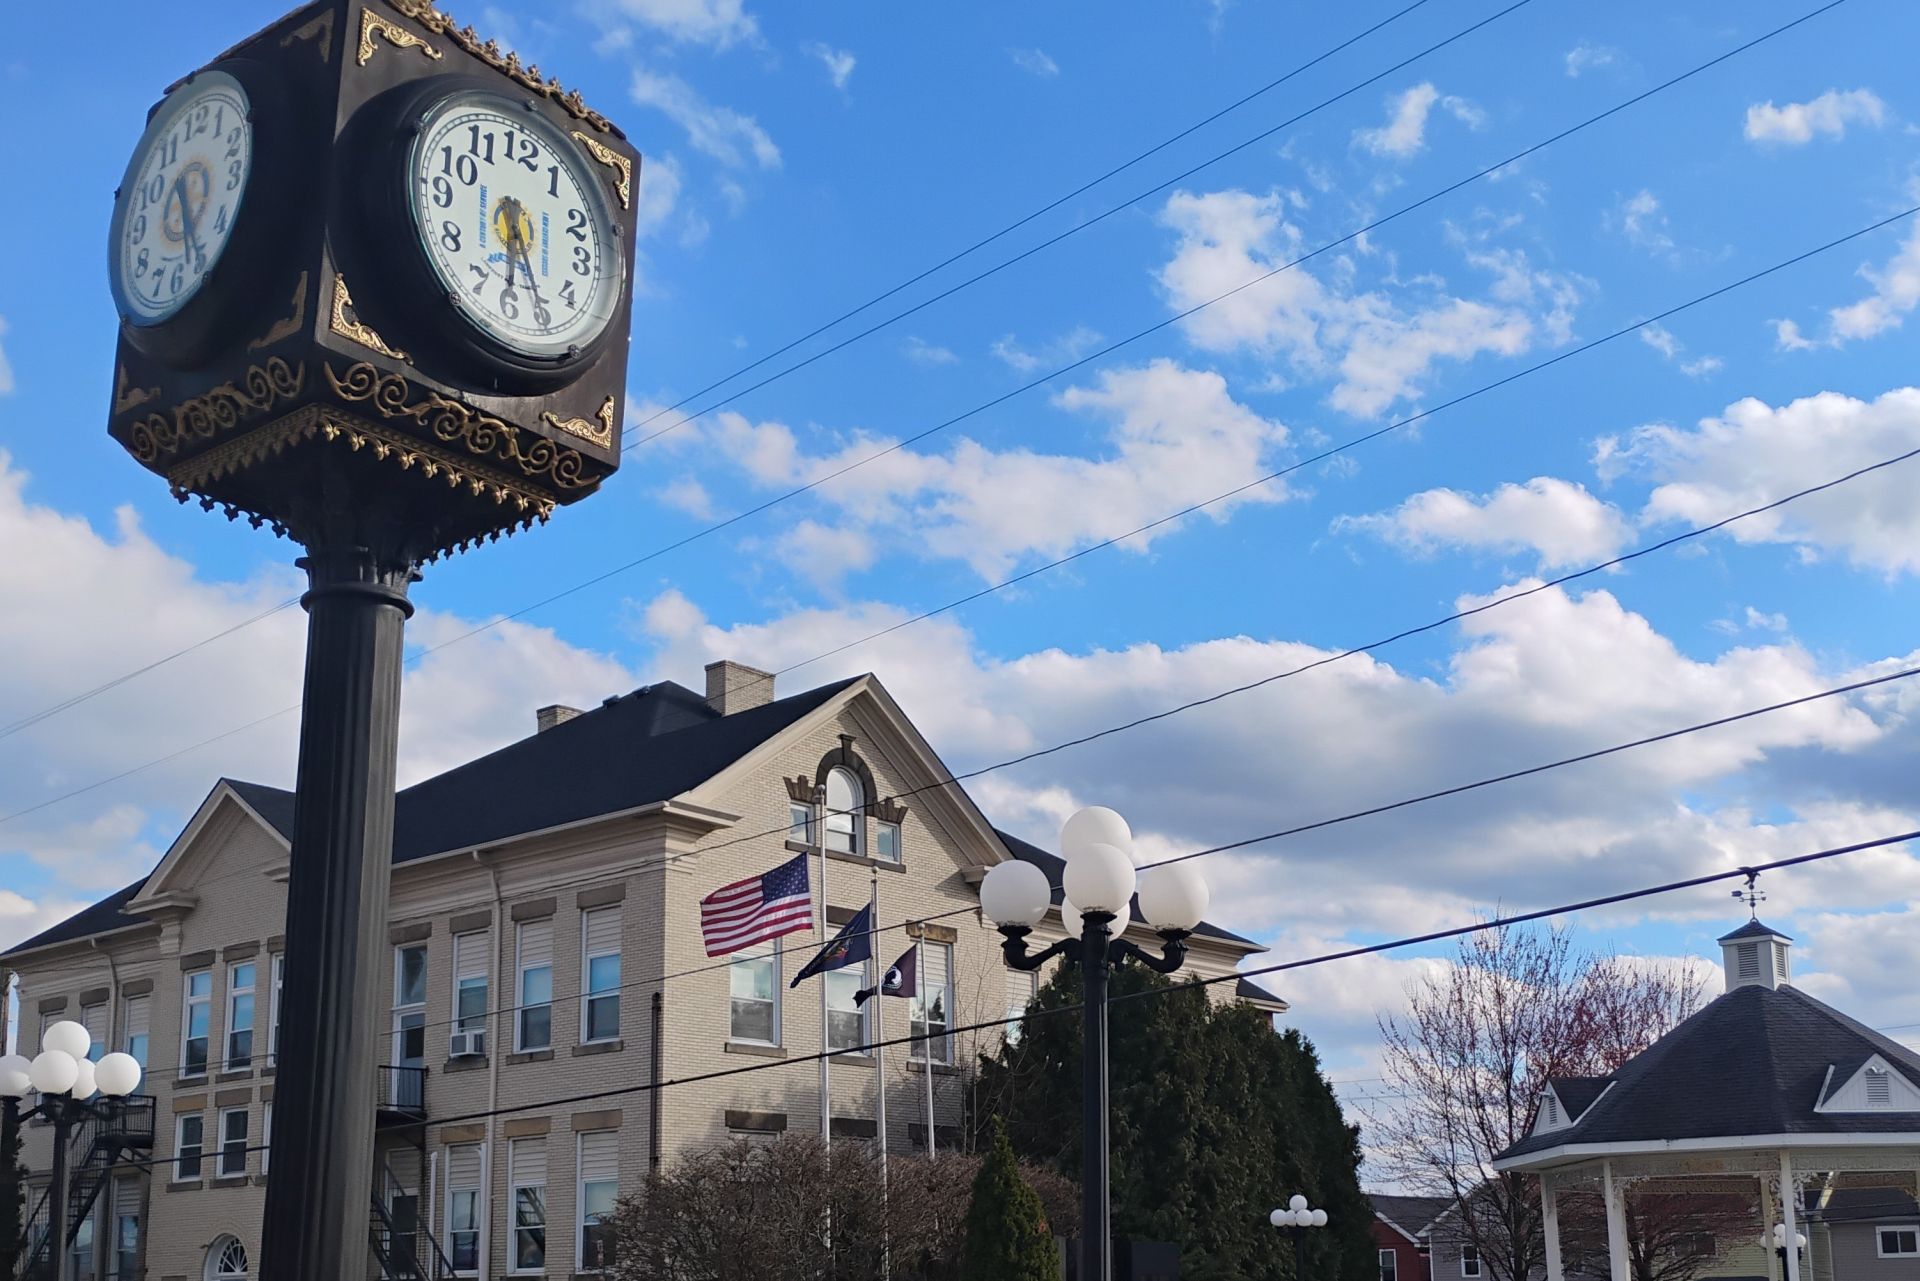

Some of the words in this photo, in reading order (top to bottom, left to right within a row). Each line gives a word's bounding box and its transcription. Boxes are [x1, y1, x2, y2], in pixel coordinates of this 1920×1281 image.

[183, 104, 210, 144] 12
[212, 104, 224, 139] 1
[159, 132, 179, 170] 11
[224, 126, 242, 162] 2
[468, 124, 495, 166] 11
[503, 130, 540, 172] 12
[226, 159, 242, 191] 3
[441, 145, 478, 186] 10
[547, 165, 560, 199] 1
[139, 173, 164, 211] 10
[432, 175, 454, 209] 9
[132, 214, 147, 245] 9
[213, 203, 227, 234] 4
[565, 208, 587, 242] 2
[442, 220, 462, 253] 8
[135, 247, 150, 279] 8
[170, 262, 184, 295] 6
[572, 246, 591, 277] 3
[151, 264, 167, 298] 7
[469, 262, 489, 296] 7
[558, 279, 577, 311] 4
[499, 287, 519, 320] 6
[533, 296, 551, 326] 5
